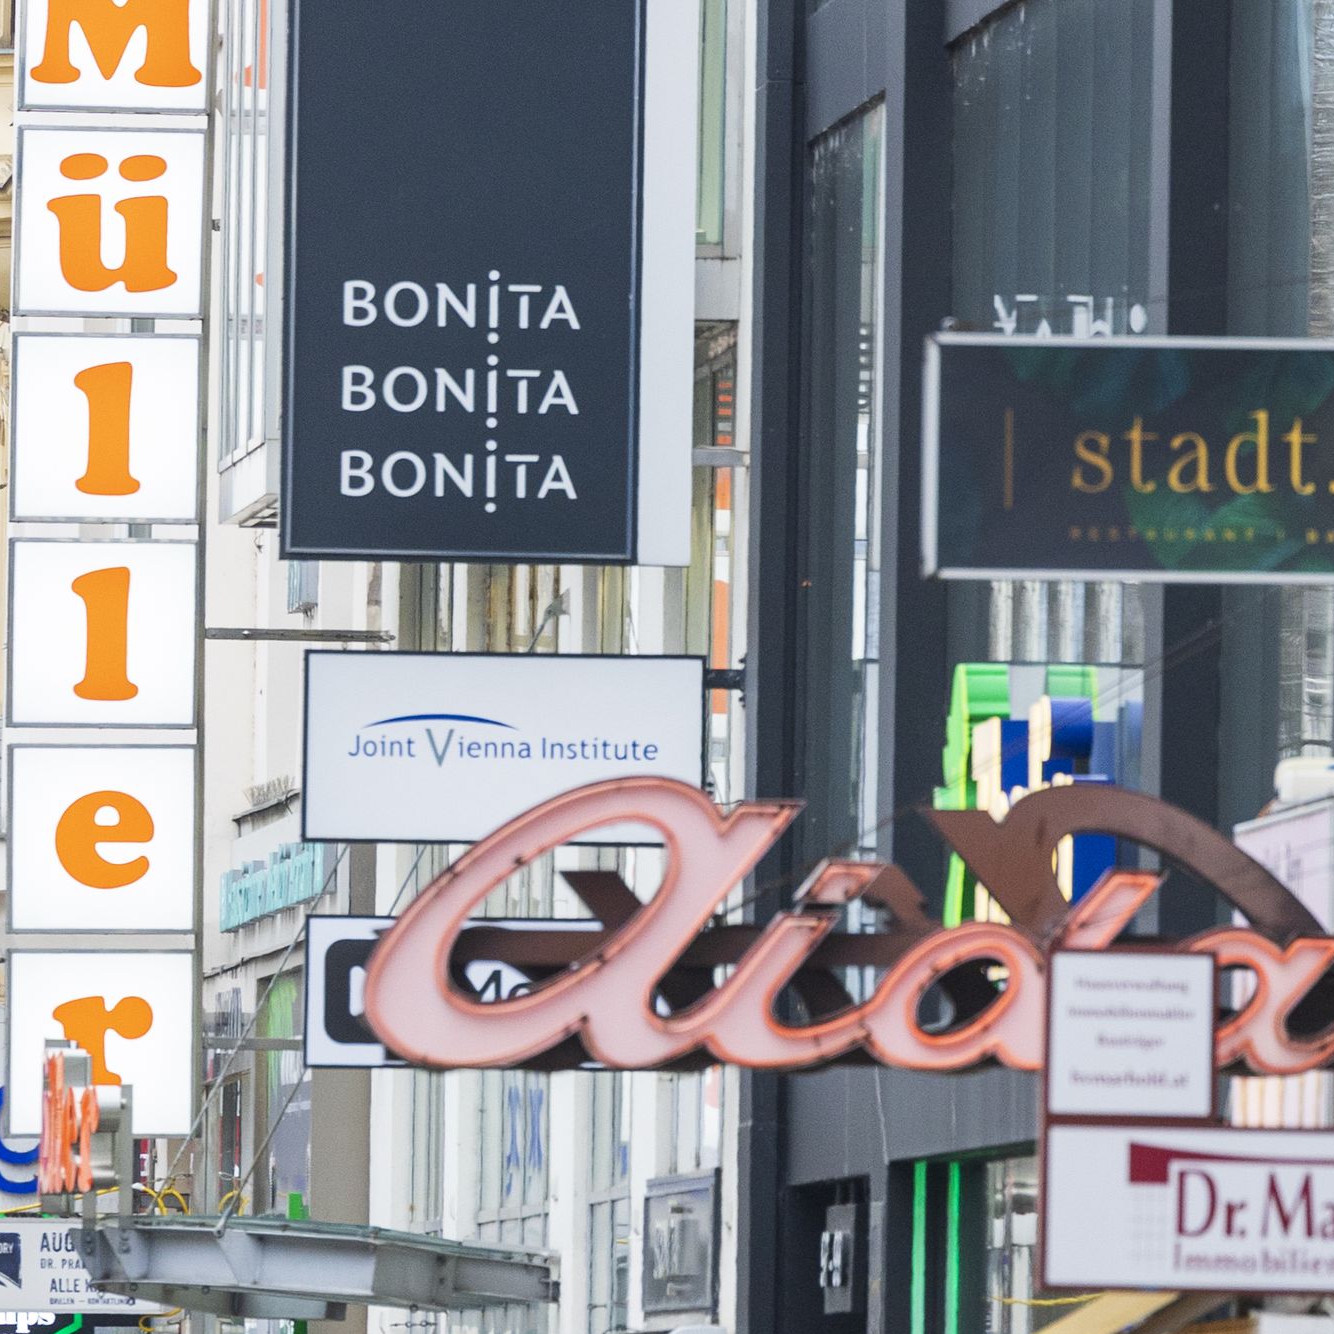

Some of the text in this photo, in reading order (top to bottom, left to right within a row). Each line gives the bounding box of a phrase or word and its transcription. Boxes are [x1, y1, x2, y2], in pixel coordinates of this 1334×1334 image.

[348, 728, 660, 768] Joint Vienna Institute
[1174, 1170, 1246, 1238] Dr.
[40, 1231, 77, 1253] AUG
[49, 1278, 81, 1293] ALLE
